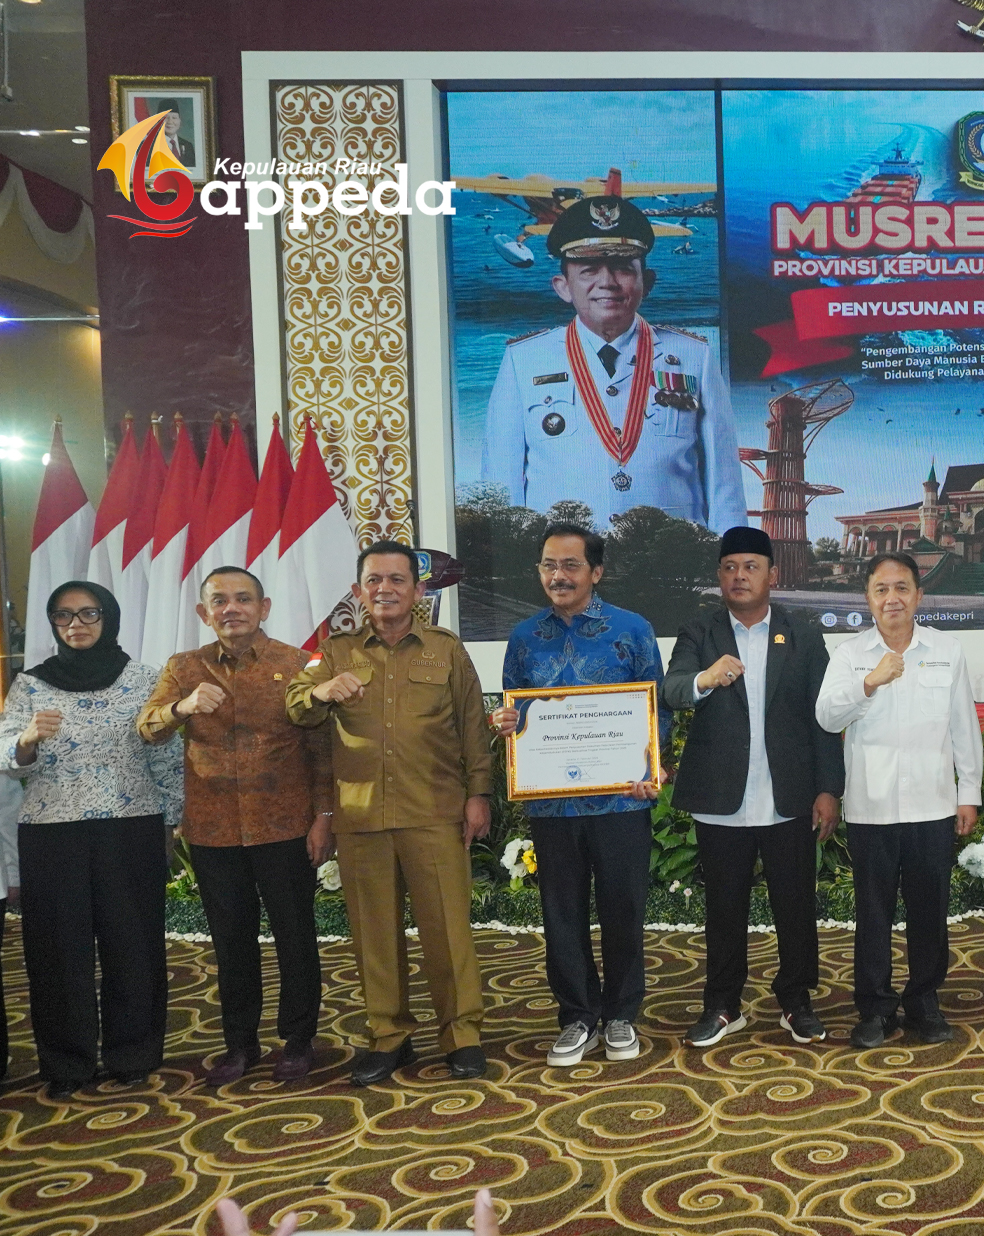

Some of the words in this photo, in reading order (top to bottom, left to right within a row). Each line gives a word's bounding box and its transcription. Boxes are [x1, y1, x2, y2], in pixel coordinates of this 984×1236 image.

[774, 260, 877, 276] PROVINSI
[828, 301, 968, 316] PENYUSUNAN
[861, 359, 903, 369] Sumber
[905, 357, 931, 367] Daya
[934, 354, 978, 365] Manusia
[884, 369, 935, 380] Didukung
[411, 660, 447, 668] GUBERNUR
[538, 712, 577, 720] SERTIFIKAT
[580, 710, 633, 718] PENGHARGAAN
[542, 733, 569, 742] Provinsi
[570, 731, 607, 741] Kepulauan
[608, 730, 624, 738] Riau
